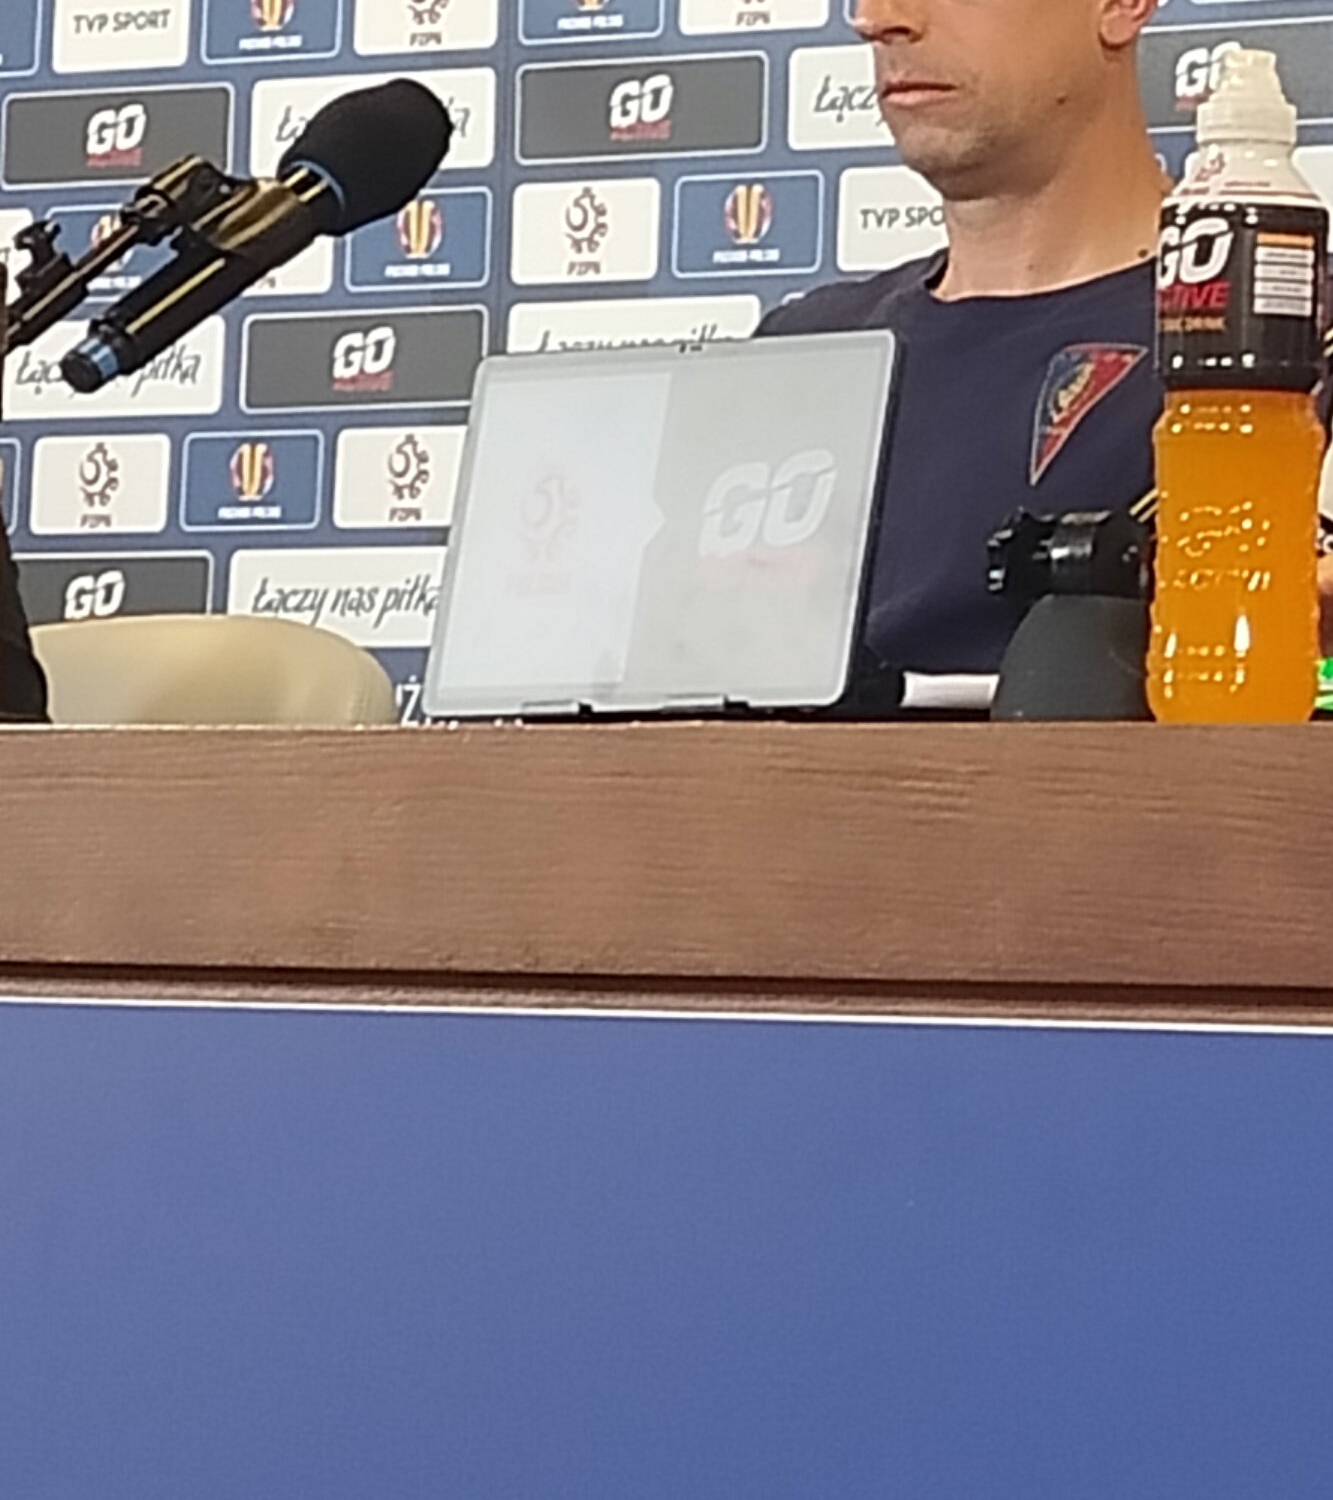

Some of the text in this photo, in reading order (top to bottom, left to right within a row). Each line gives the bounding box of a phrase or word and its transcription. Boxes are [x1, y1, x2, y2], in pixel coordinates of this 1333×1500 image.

[73, 9, 171, 35] TVP SPORT
[610, 74, 674, 126] GO
[813, 75, 885, 126] Łącz
[86, 103, 146, 155] GO
[860, 206, 945, 230] TVP SPO
[1159, 217, 1233, 289] GO
[333, 326, 395, 378] GO
[699, 449, 836, 557] GO
[65, 570, 125, 619] GO
[253, 575, 440, 629] Łączy nas piłka
